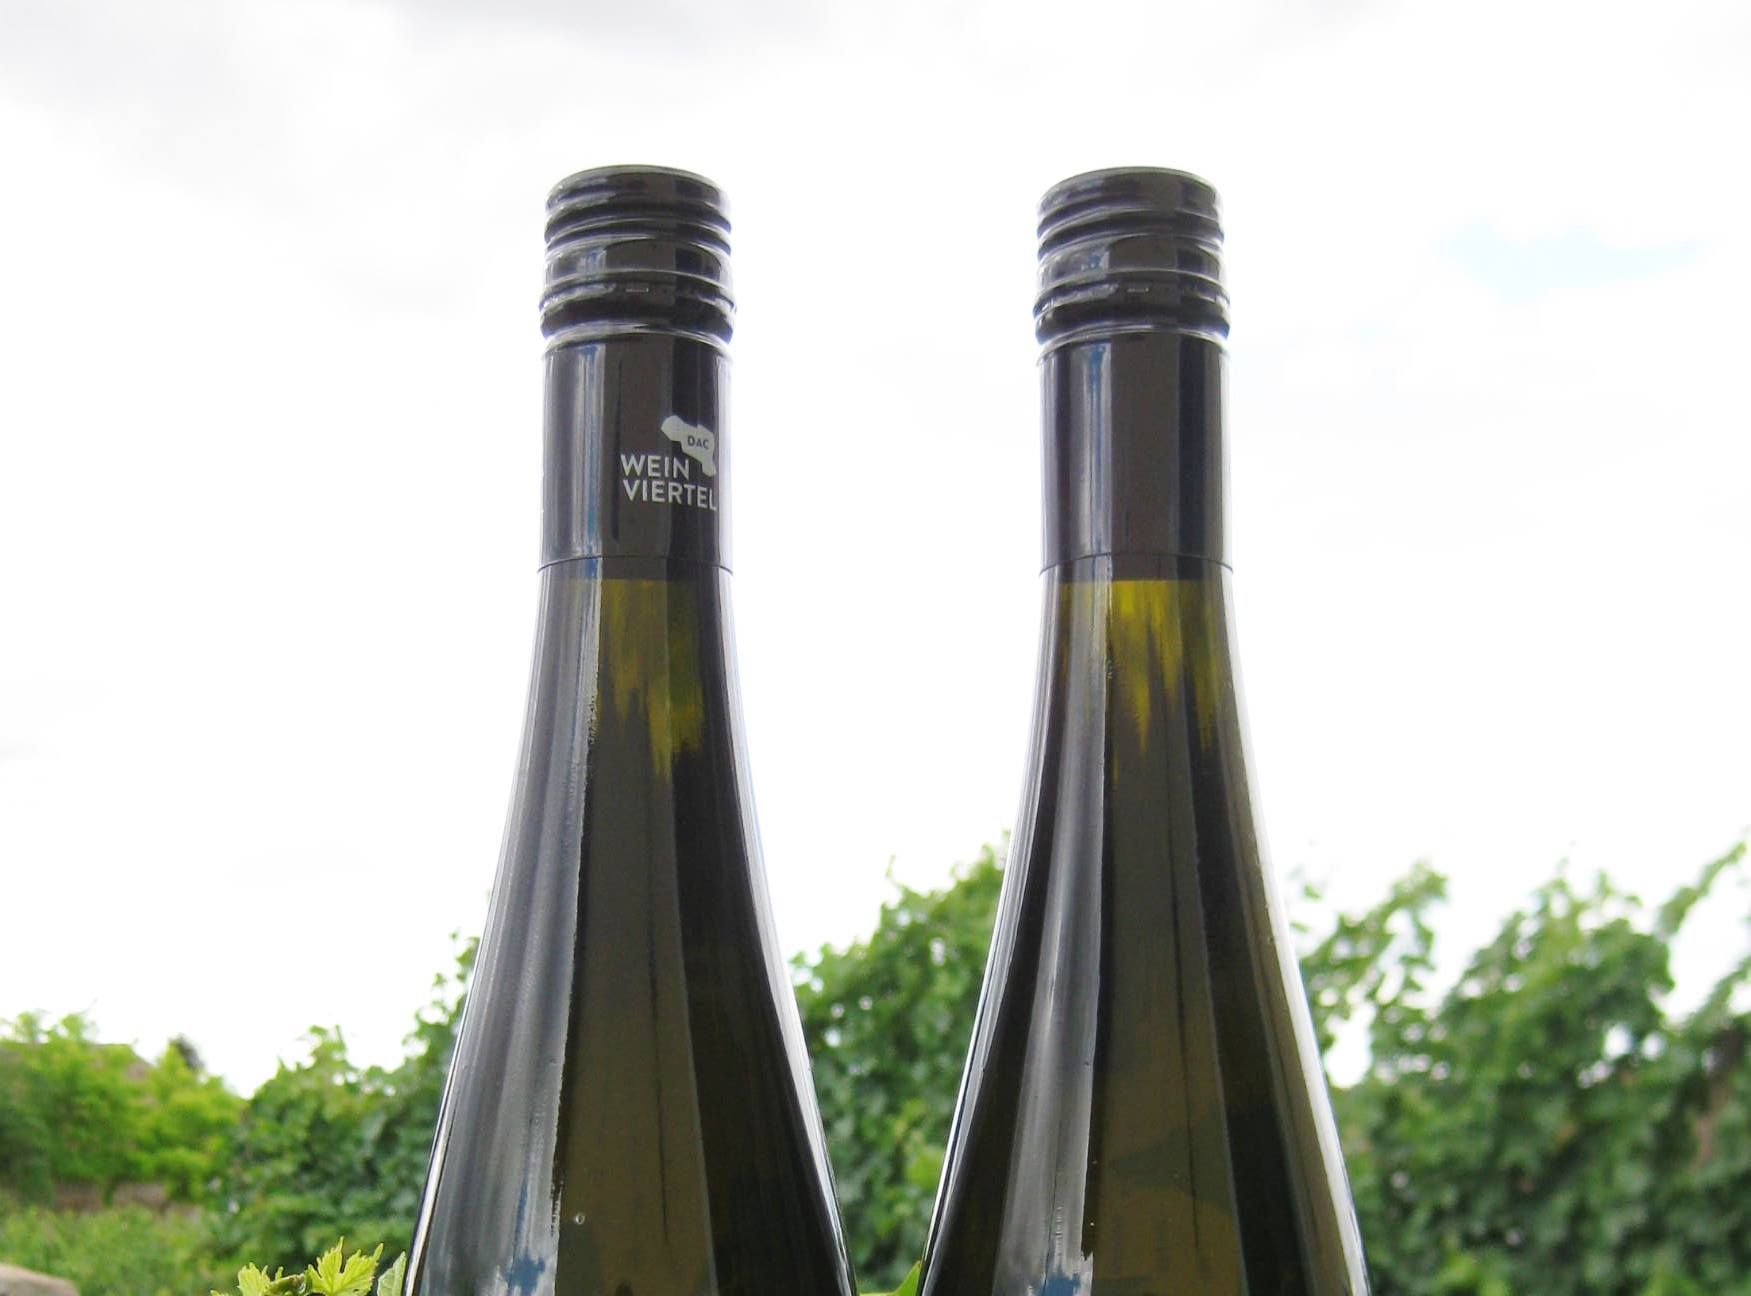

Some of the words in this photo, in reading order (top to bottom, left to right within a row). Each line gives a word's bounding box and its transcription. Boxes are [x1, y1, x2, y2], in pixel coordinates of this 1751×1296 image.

[687, 435, 709, 450] DAC
[620, 454, 689, 480] WEIN
[623, 480, 717, 511] VIERTEL
